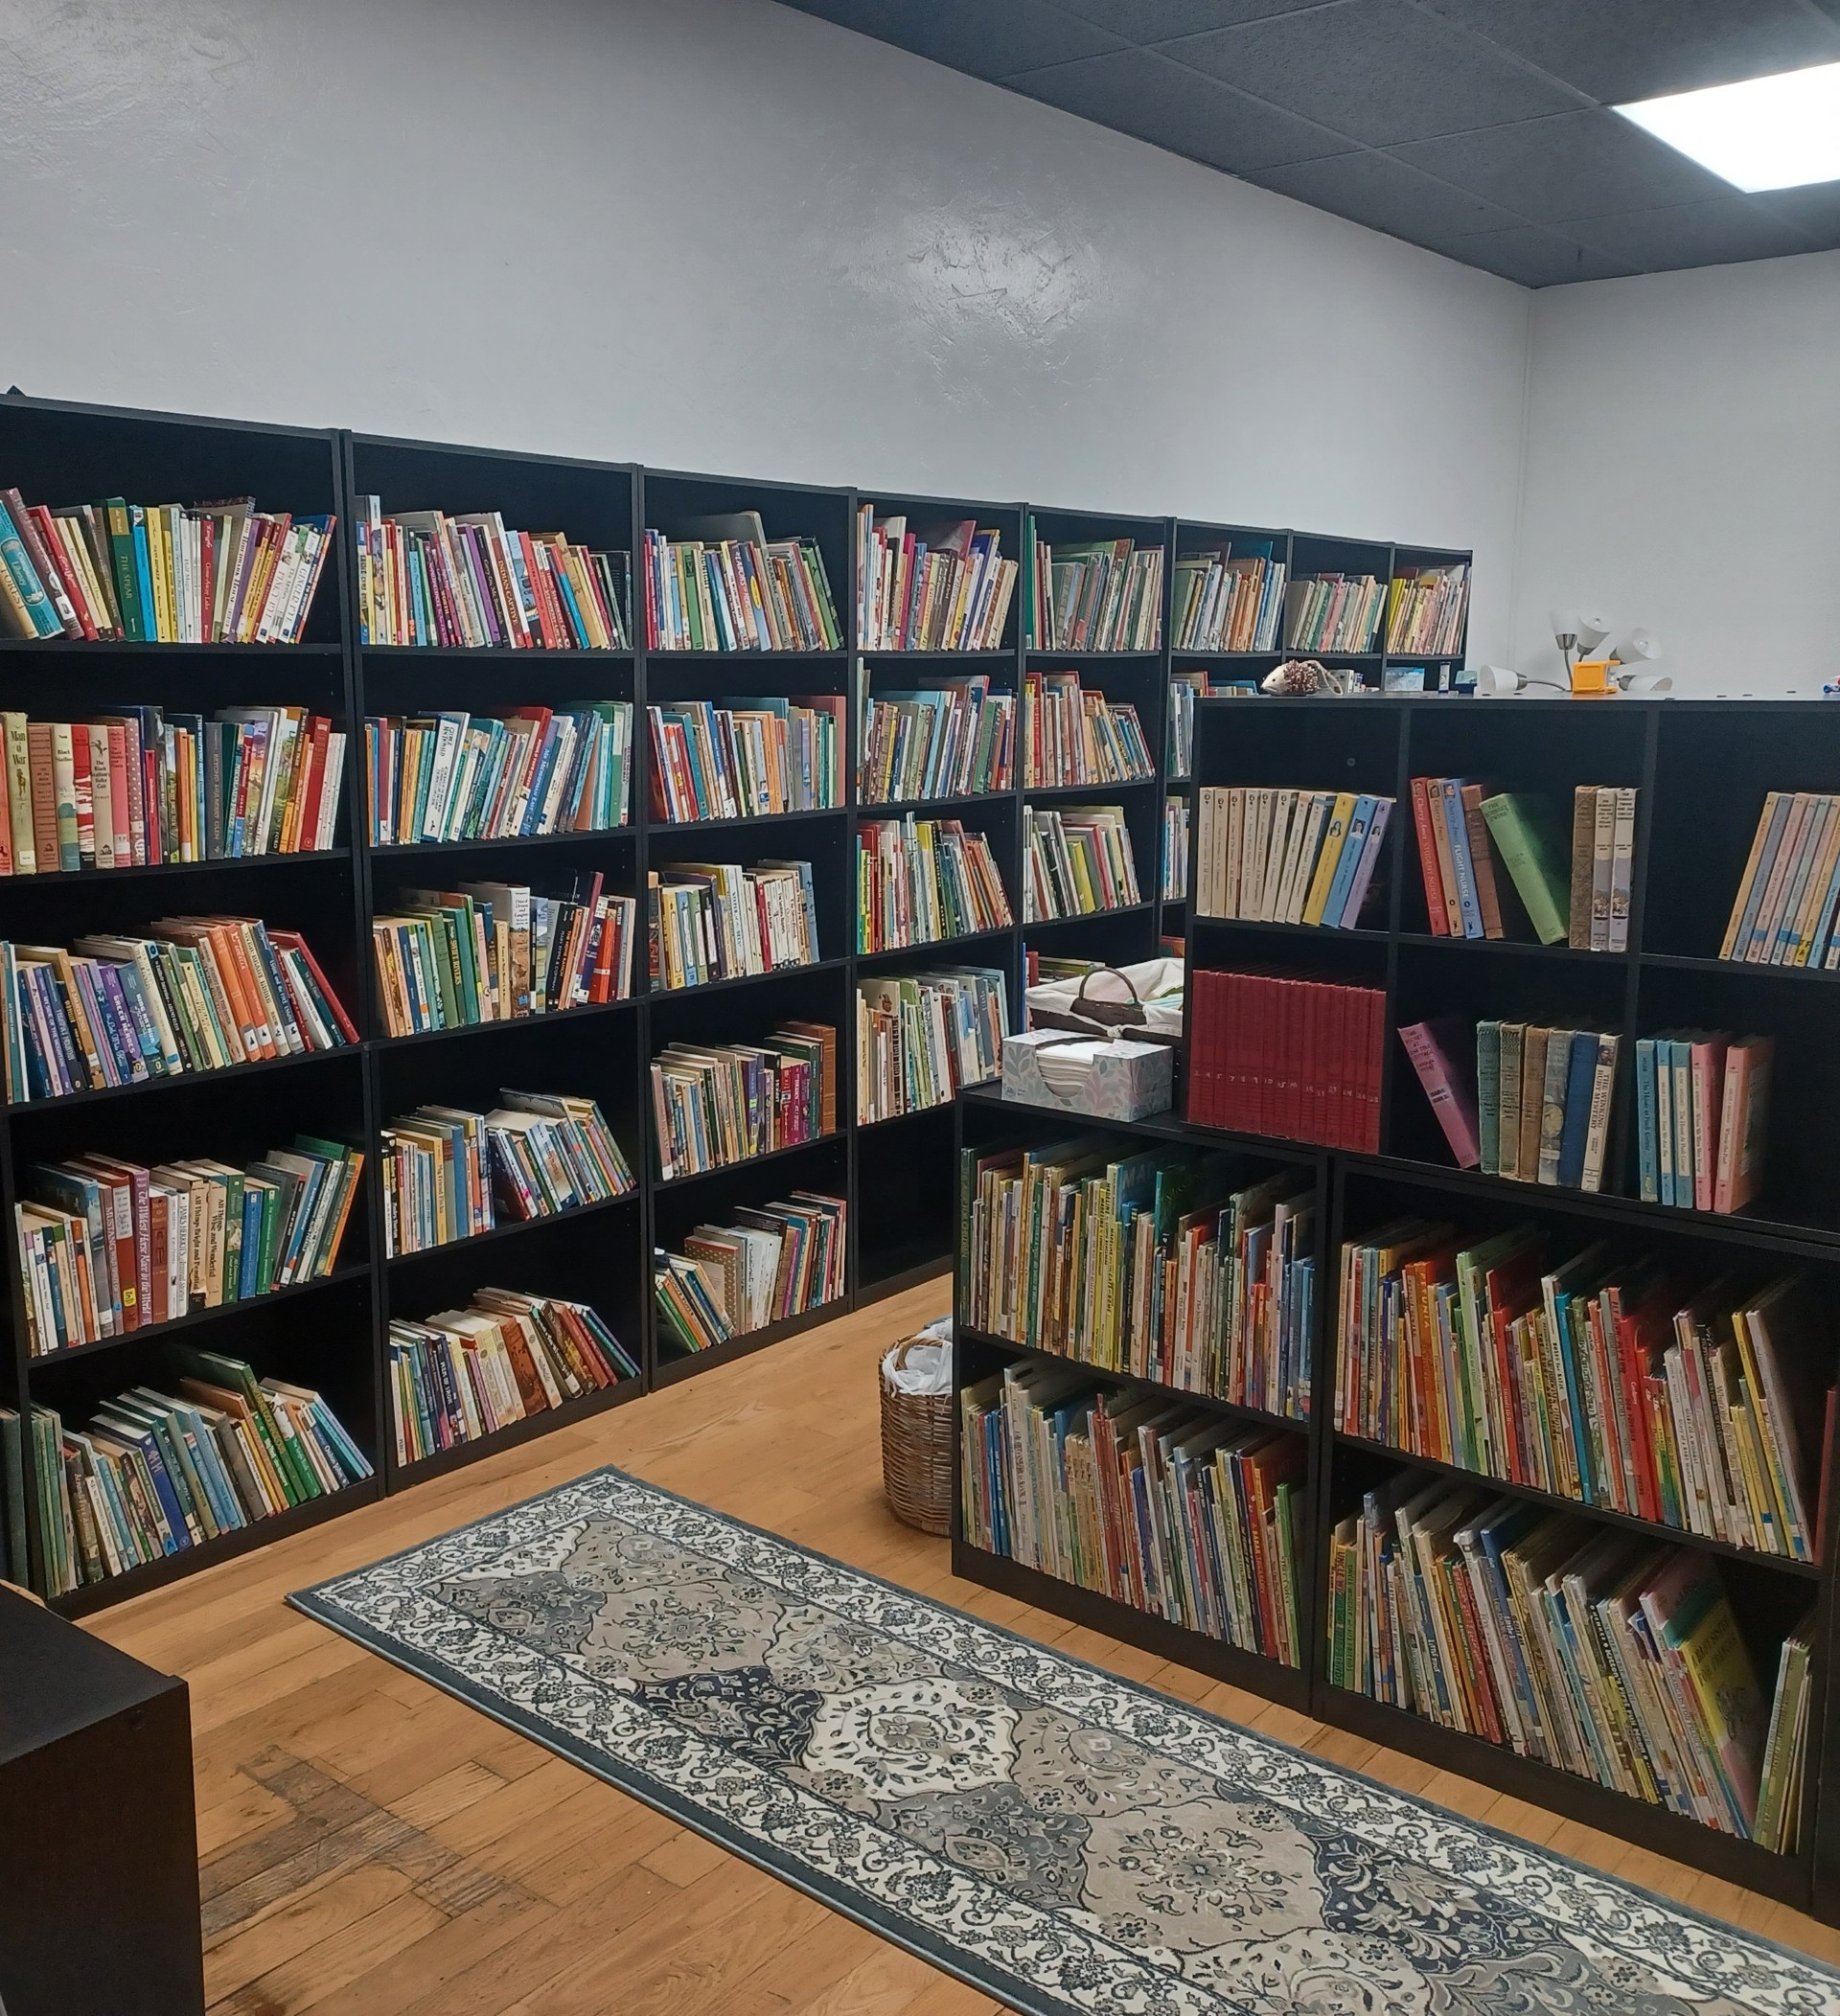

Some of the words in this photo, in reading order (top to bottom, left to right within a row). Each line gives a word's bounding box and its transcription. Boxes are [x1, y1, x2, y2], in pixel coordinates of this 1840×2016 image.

[1414, 797, 1426, 821] Cherry
[1453, 842, 1464, 871] FLIGHT
[1458, 873, 1469, 899] NURSE
[135, 993, 147, 1012] KING
[141, 1013, 155, 1044] ARTHUR
[1594, 1068, 1604, 1091] RUBY
[1589, 1091, 1600, 1129] MYSTERY
[1597, 1091, 1607, 1128] WINKING
[209, 1231, 218, 1244] and
[210, 1214, 218, 1231] Wise
[207, 1244, 217, 1277] Wonderful
[1417, 1271, 1431, 1328] PETUNIA
[438, 1361, 448, 1377] MEN
[444, 1386, 453, 1405] IRON
[322, 1444, 338, 1465] Onion
[332, 1462, 346, 1478] John
[1251, 1530, 1260, 1554] BABAR
[1591, 1610, 1605, 1642] HENKES
[1603, 1648, 1621, 1684] Kitten's
[1616, 1685, 1628, 1707] First
[1630, 1728, 1643, 1751] Moon
